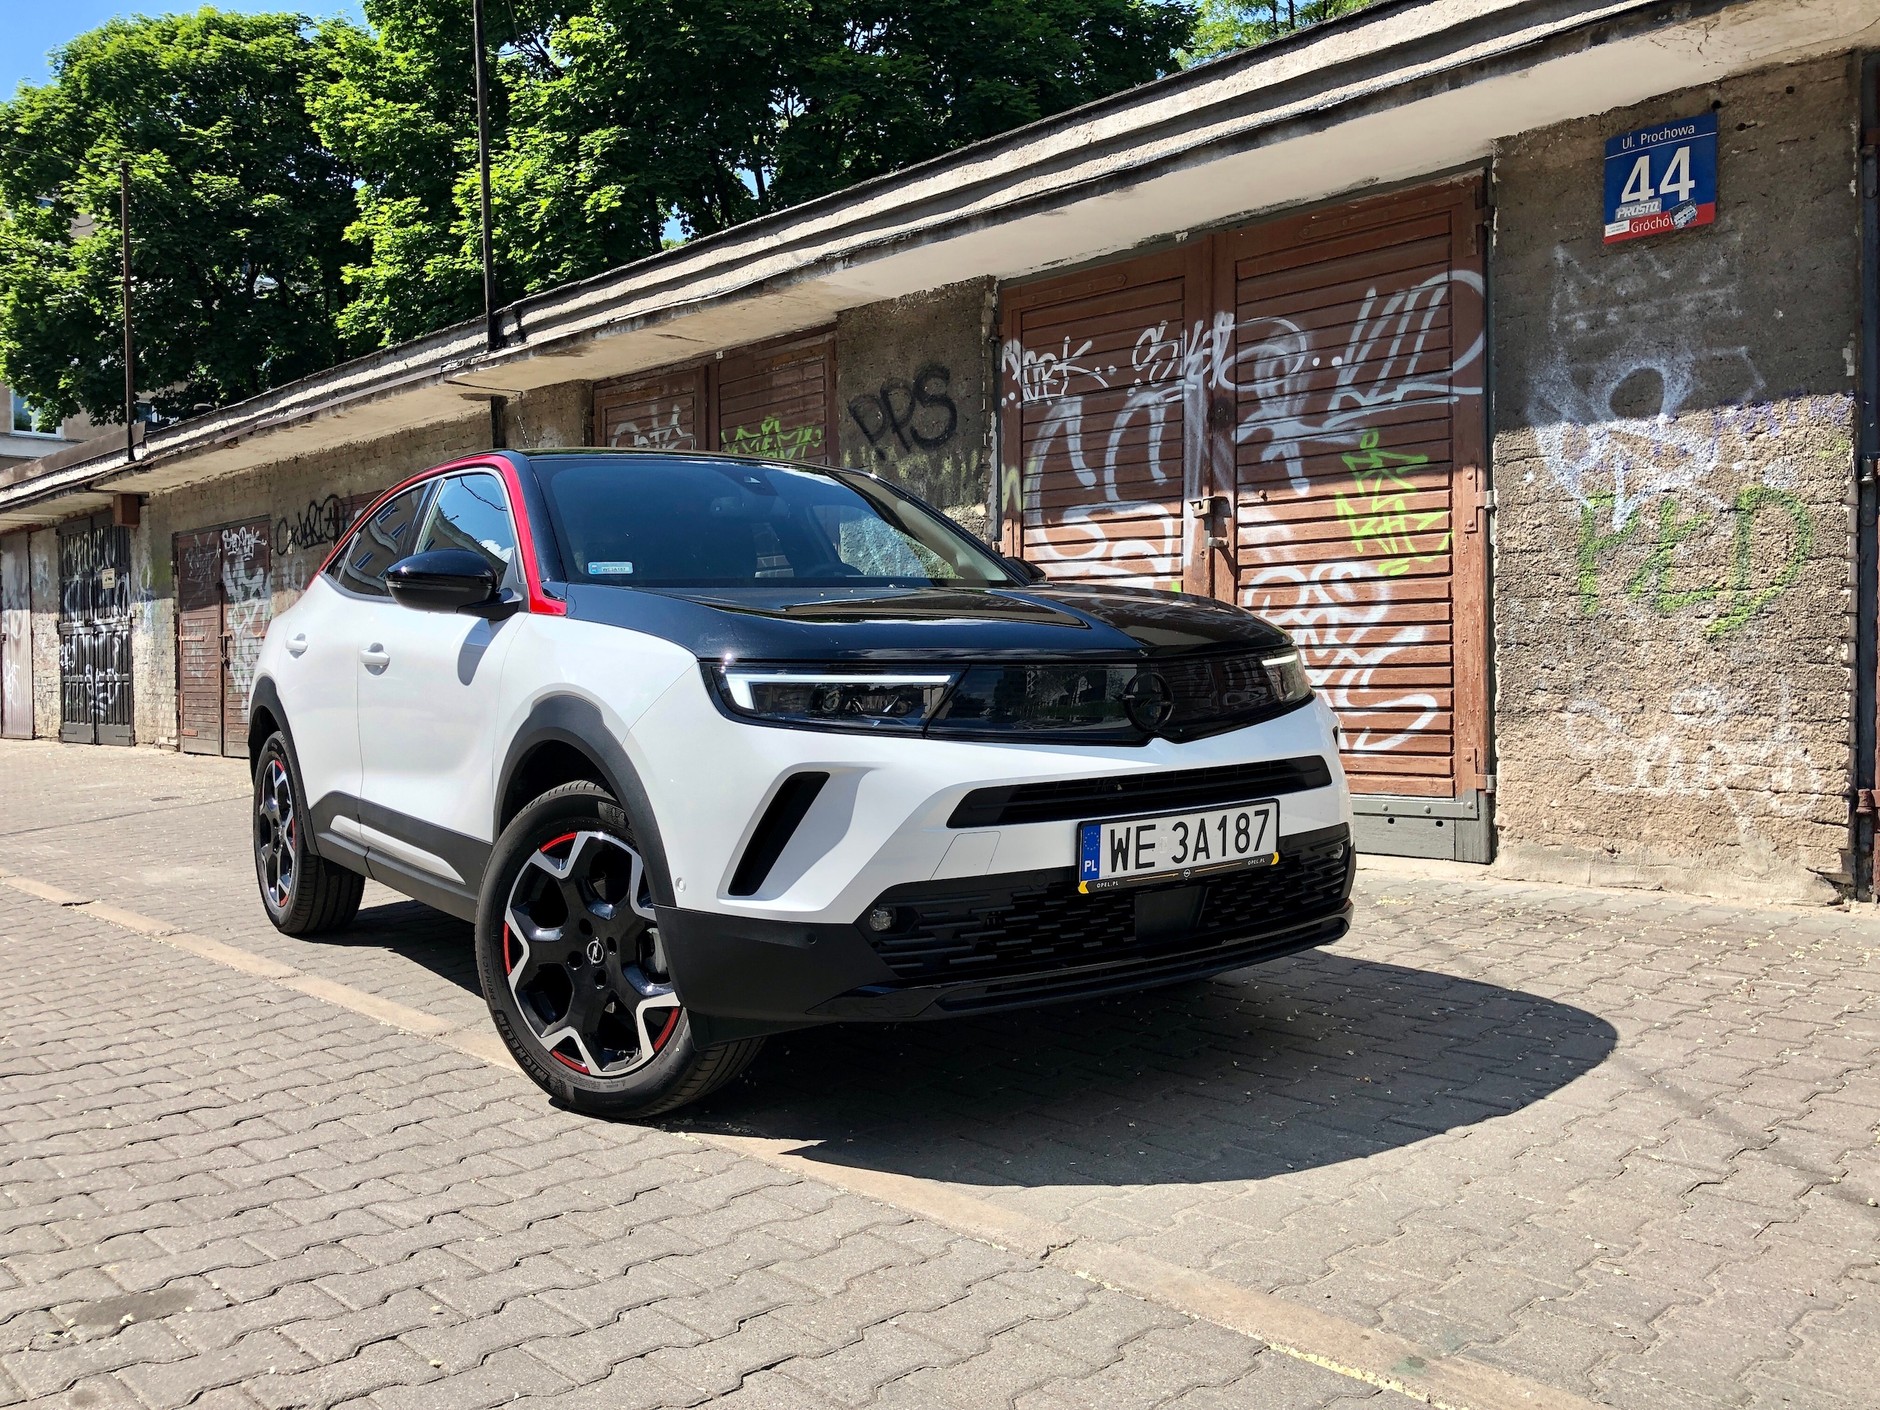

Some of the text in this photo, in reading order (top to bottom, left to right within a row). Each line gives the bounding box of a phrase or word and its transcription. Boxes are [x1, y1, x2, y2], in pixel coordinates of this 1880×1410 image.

[1622, 124, 1695, 149] Ul. Prochowa
[1621, 146, 1695, 203] 44
[1084, 860, 1097, 872] PL
[1110, 809, 1269, 873] WE 3A187
[496, 1012, 549, 1085] MICHELIN
